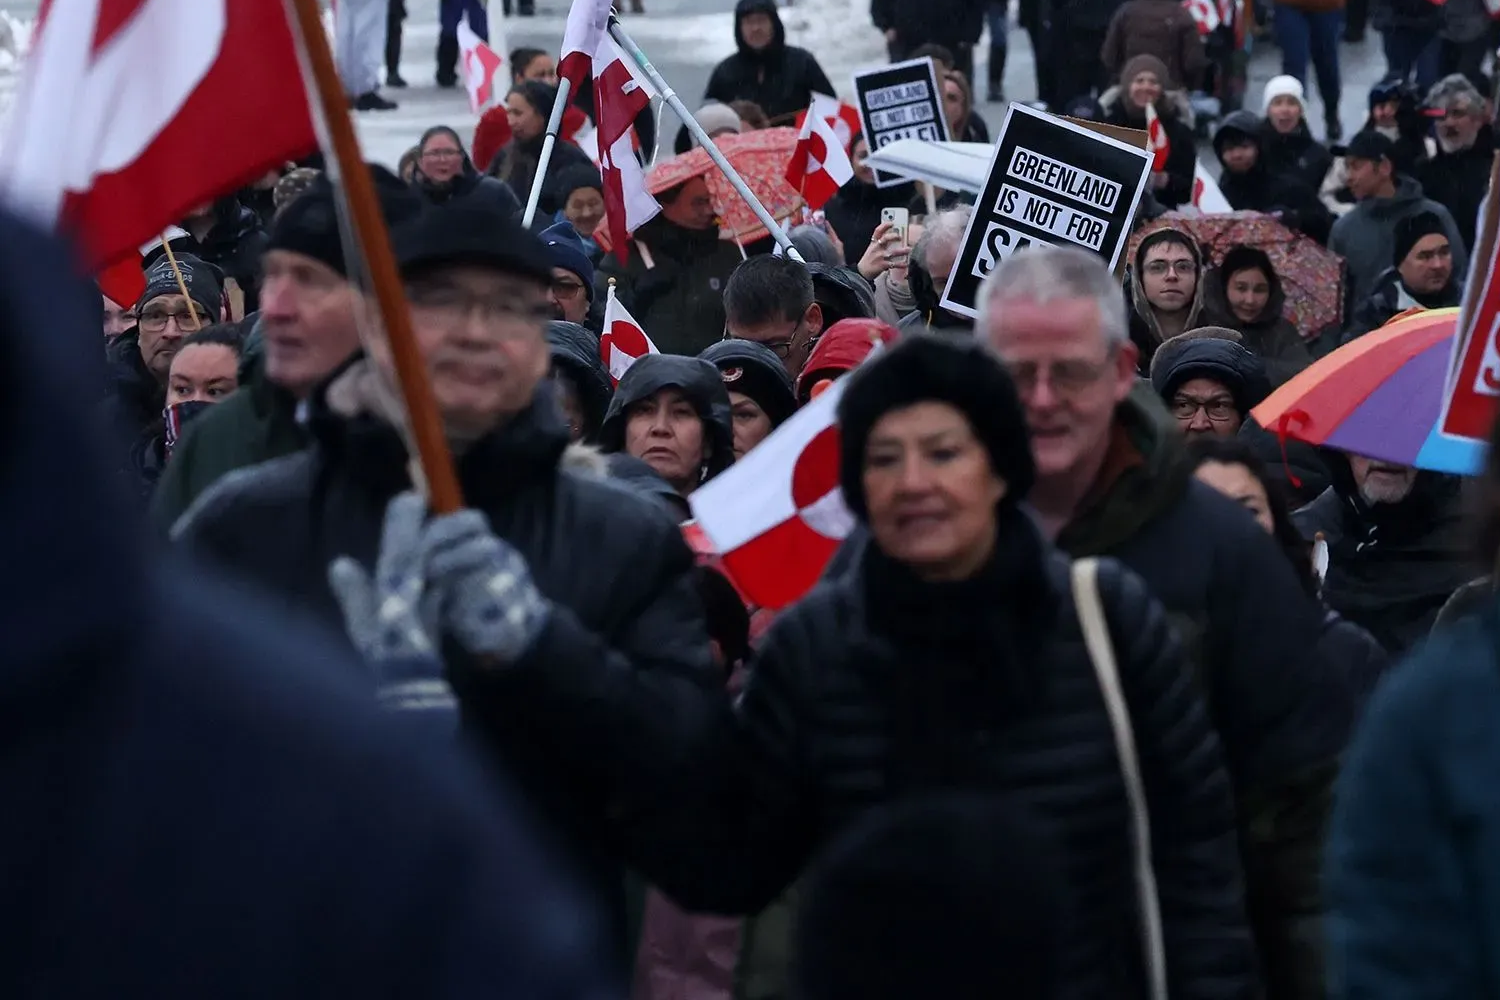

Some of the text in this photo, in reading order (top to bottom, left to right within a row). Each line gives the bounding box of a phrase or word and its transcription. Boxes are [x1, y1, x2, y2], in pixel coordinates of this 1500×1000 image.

[1012, 151, 1117, 208] GREENLAND
[998, 188, 1103, 247] IS NOT FOR
